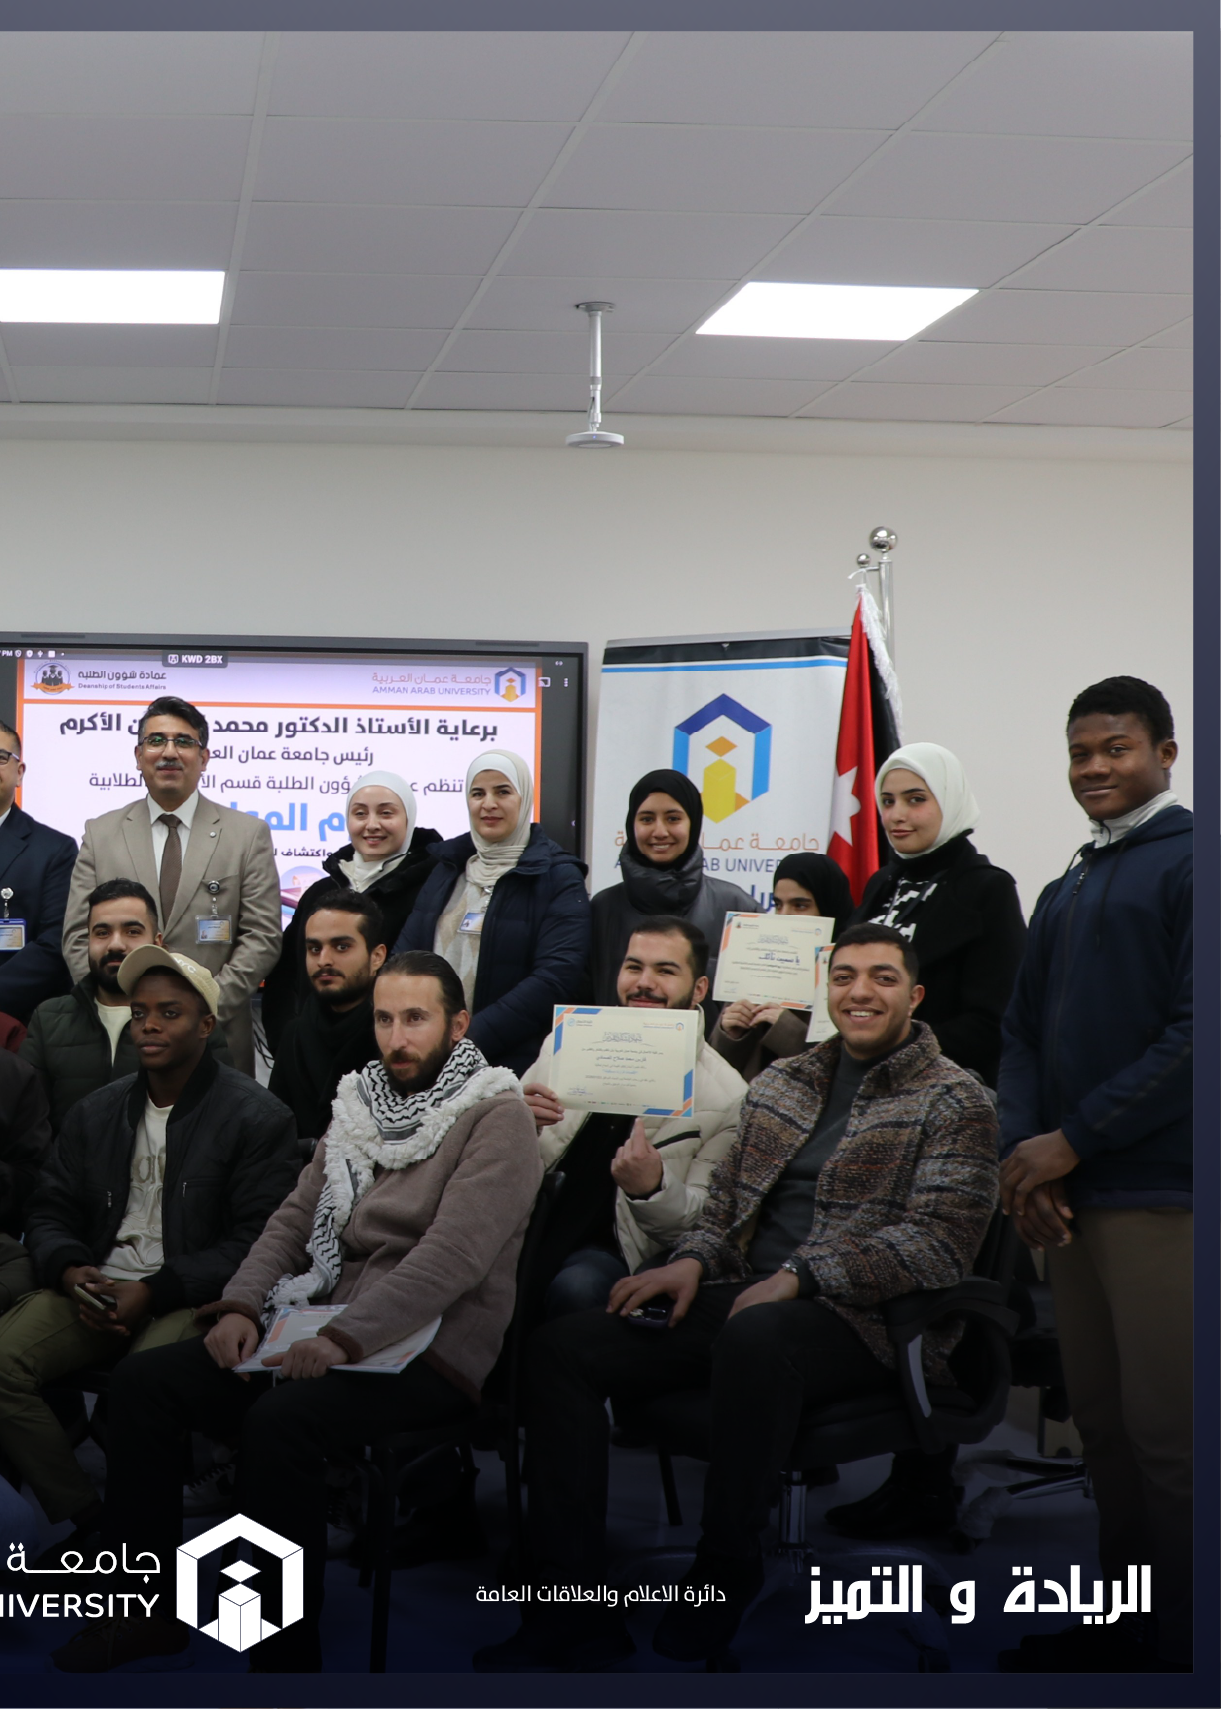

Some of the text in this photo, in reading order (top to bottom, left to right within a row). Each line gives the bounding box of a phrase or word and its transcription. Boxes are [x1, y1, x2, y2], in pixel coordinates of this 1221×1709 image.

[181, 654, 223, 665] KWD 2BX
[139, 670, 167, 680] عمادة
[371, 672, 492, 687] جامعة عمان العربية
[372, 686, 492, 696] AMMAN ARAB UNIVERSITY
[59, 711, 122, 735] الأكرم
[212, 718, 270, 733] محمد
[275, 716, 348, 738] الدكتور
[354, 716, 430, 735] الأستاذ
[435, 718, 498, 742] برعاية
[238, 746, 278, 764] عمان
[280, 747, 330, 765] جامعة
[333, 747, 374, 767] رئيس
[89, 772, 145, 791] لطلابية
[220, 776, 262, 793] قسم
[267, 775, 315, 794] الطلبة
[319, 774, 363, 795] ؤون
[422, 778, 464, 796] تنظم
[701, 831, 745, 852] عما
